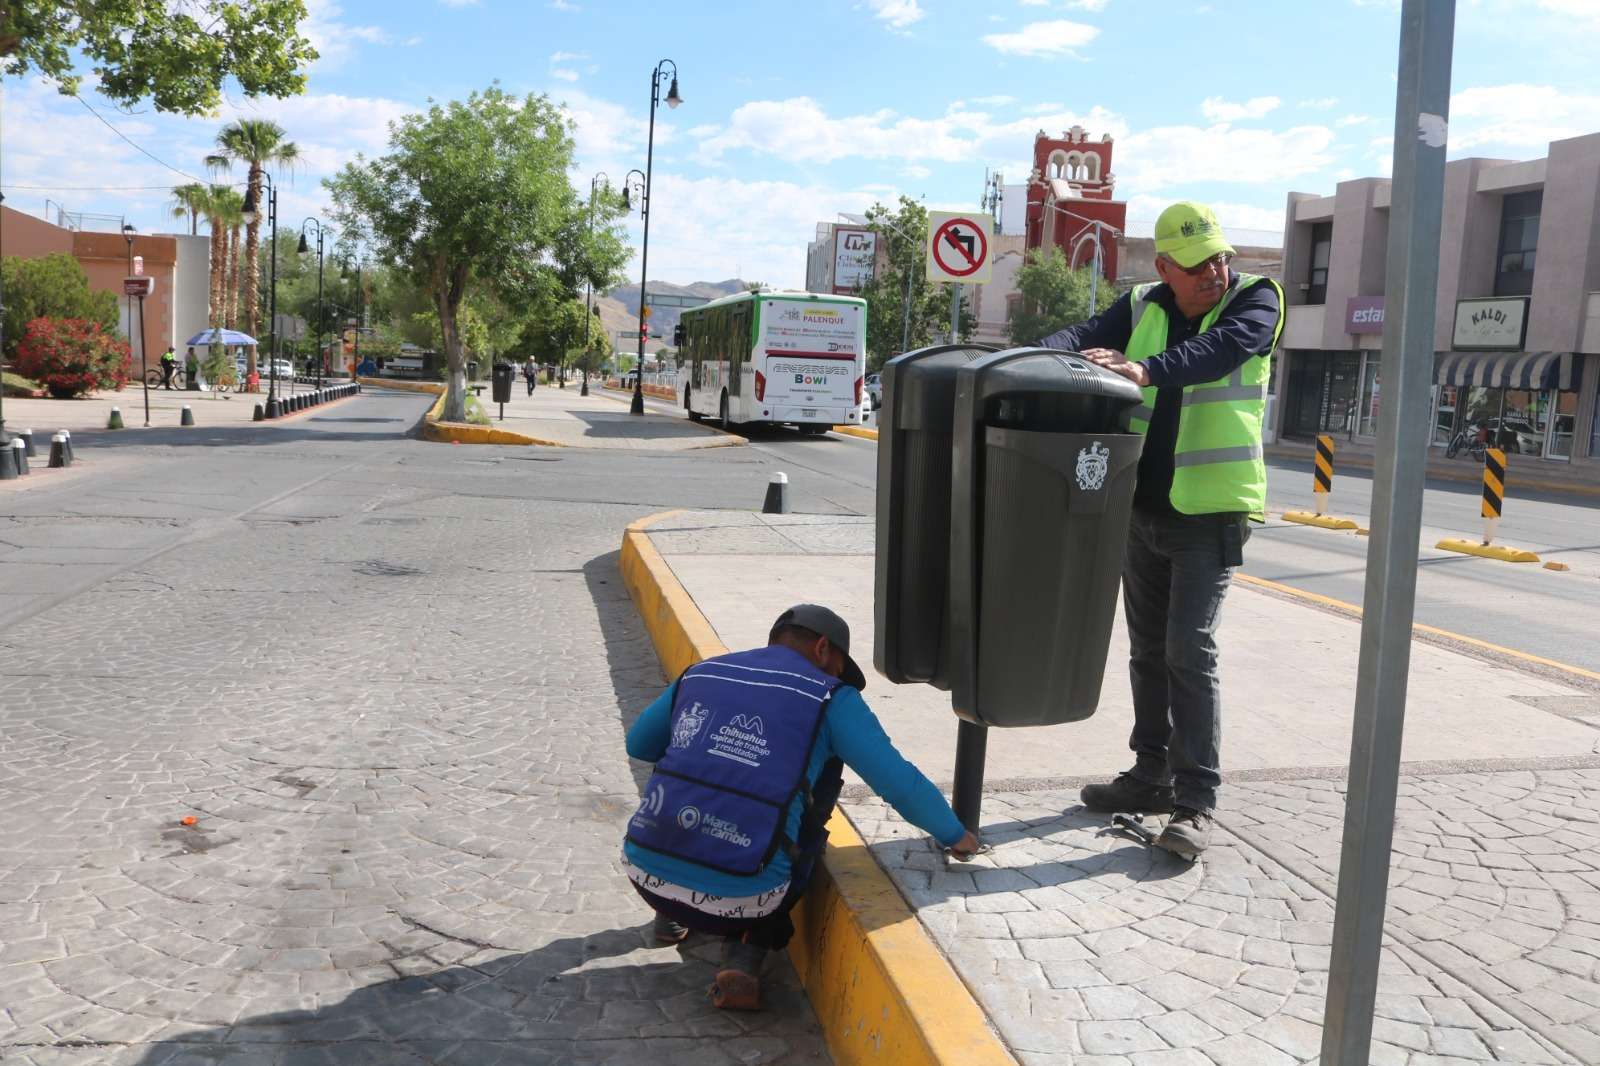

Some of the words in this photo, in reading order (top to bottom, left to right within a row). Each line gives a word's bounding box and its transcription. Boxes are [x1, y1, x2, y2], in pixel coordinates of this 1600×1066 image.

[1471, 307, 1507, 325] KALDI
[710, 733, 734, 746] capital
[734, 739, 745, 748] de
[744, 742, 770, 756] trabajo
[719, 726, 767, 747] Chihuahua
[715, 741, 721, 750] y
[720, 743, 758, 760] resultados
[702, 813, 738, 833] Marca
[702, 826, 710, 835] el
[710, 828, 752, 848] cambio
